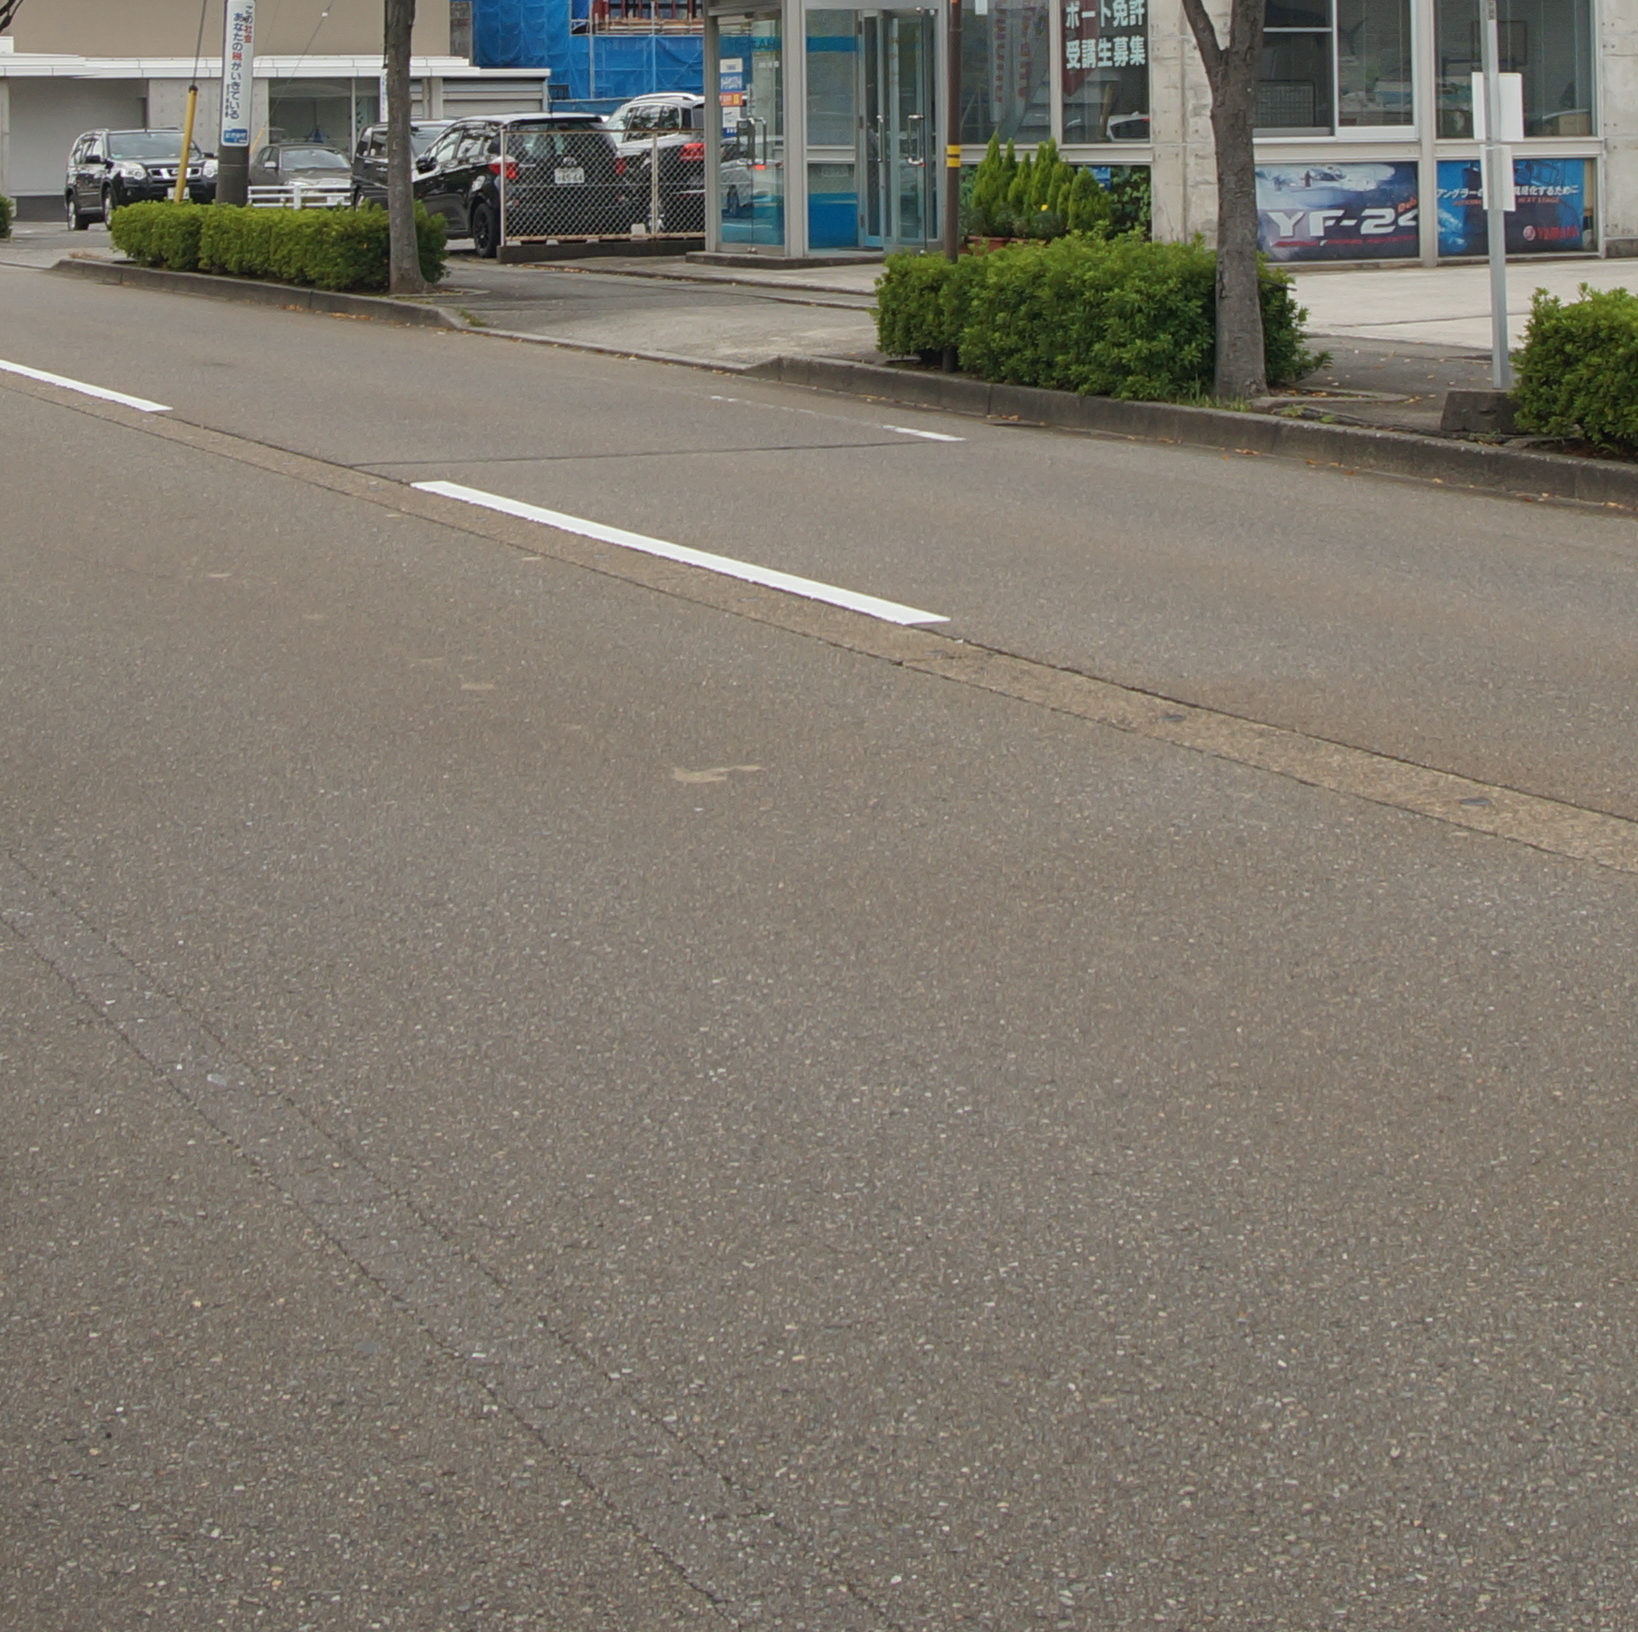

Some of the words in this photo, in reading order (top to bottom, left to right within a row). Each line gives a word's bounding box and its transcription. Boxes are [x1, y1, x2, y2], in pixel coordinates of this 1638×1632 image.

[1065, 35, 1146, 70] 受講生募集
